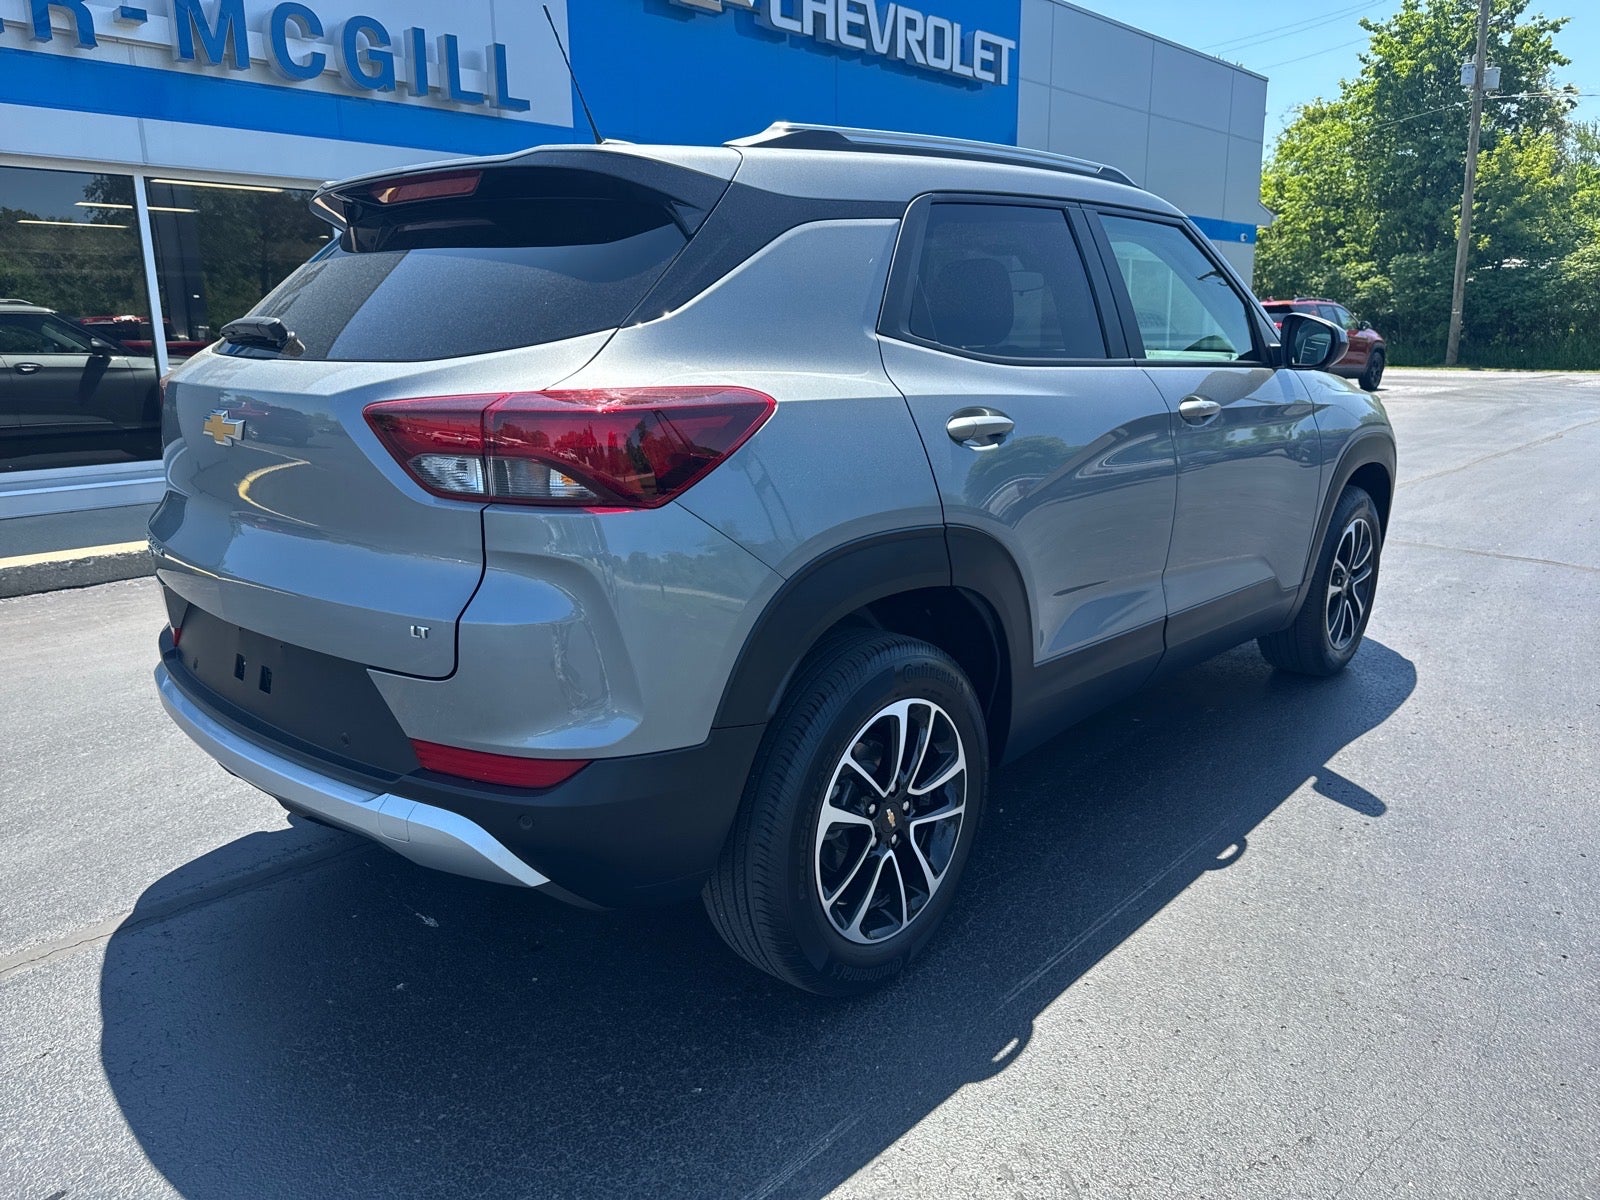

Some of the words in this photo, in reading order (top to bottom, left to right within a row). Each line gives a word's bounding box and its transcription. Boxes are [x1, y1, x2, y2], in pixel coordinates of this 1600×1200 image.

[0, 0, 531, 112] R-MCGILL
[410, 625, 430, 639] LT
[902, 662, 960, 691] Continental
